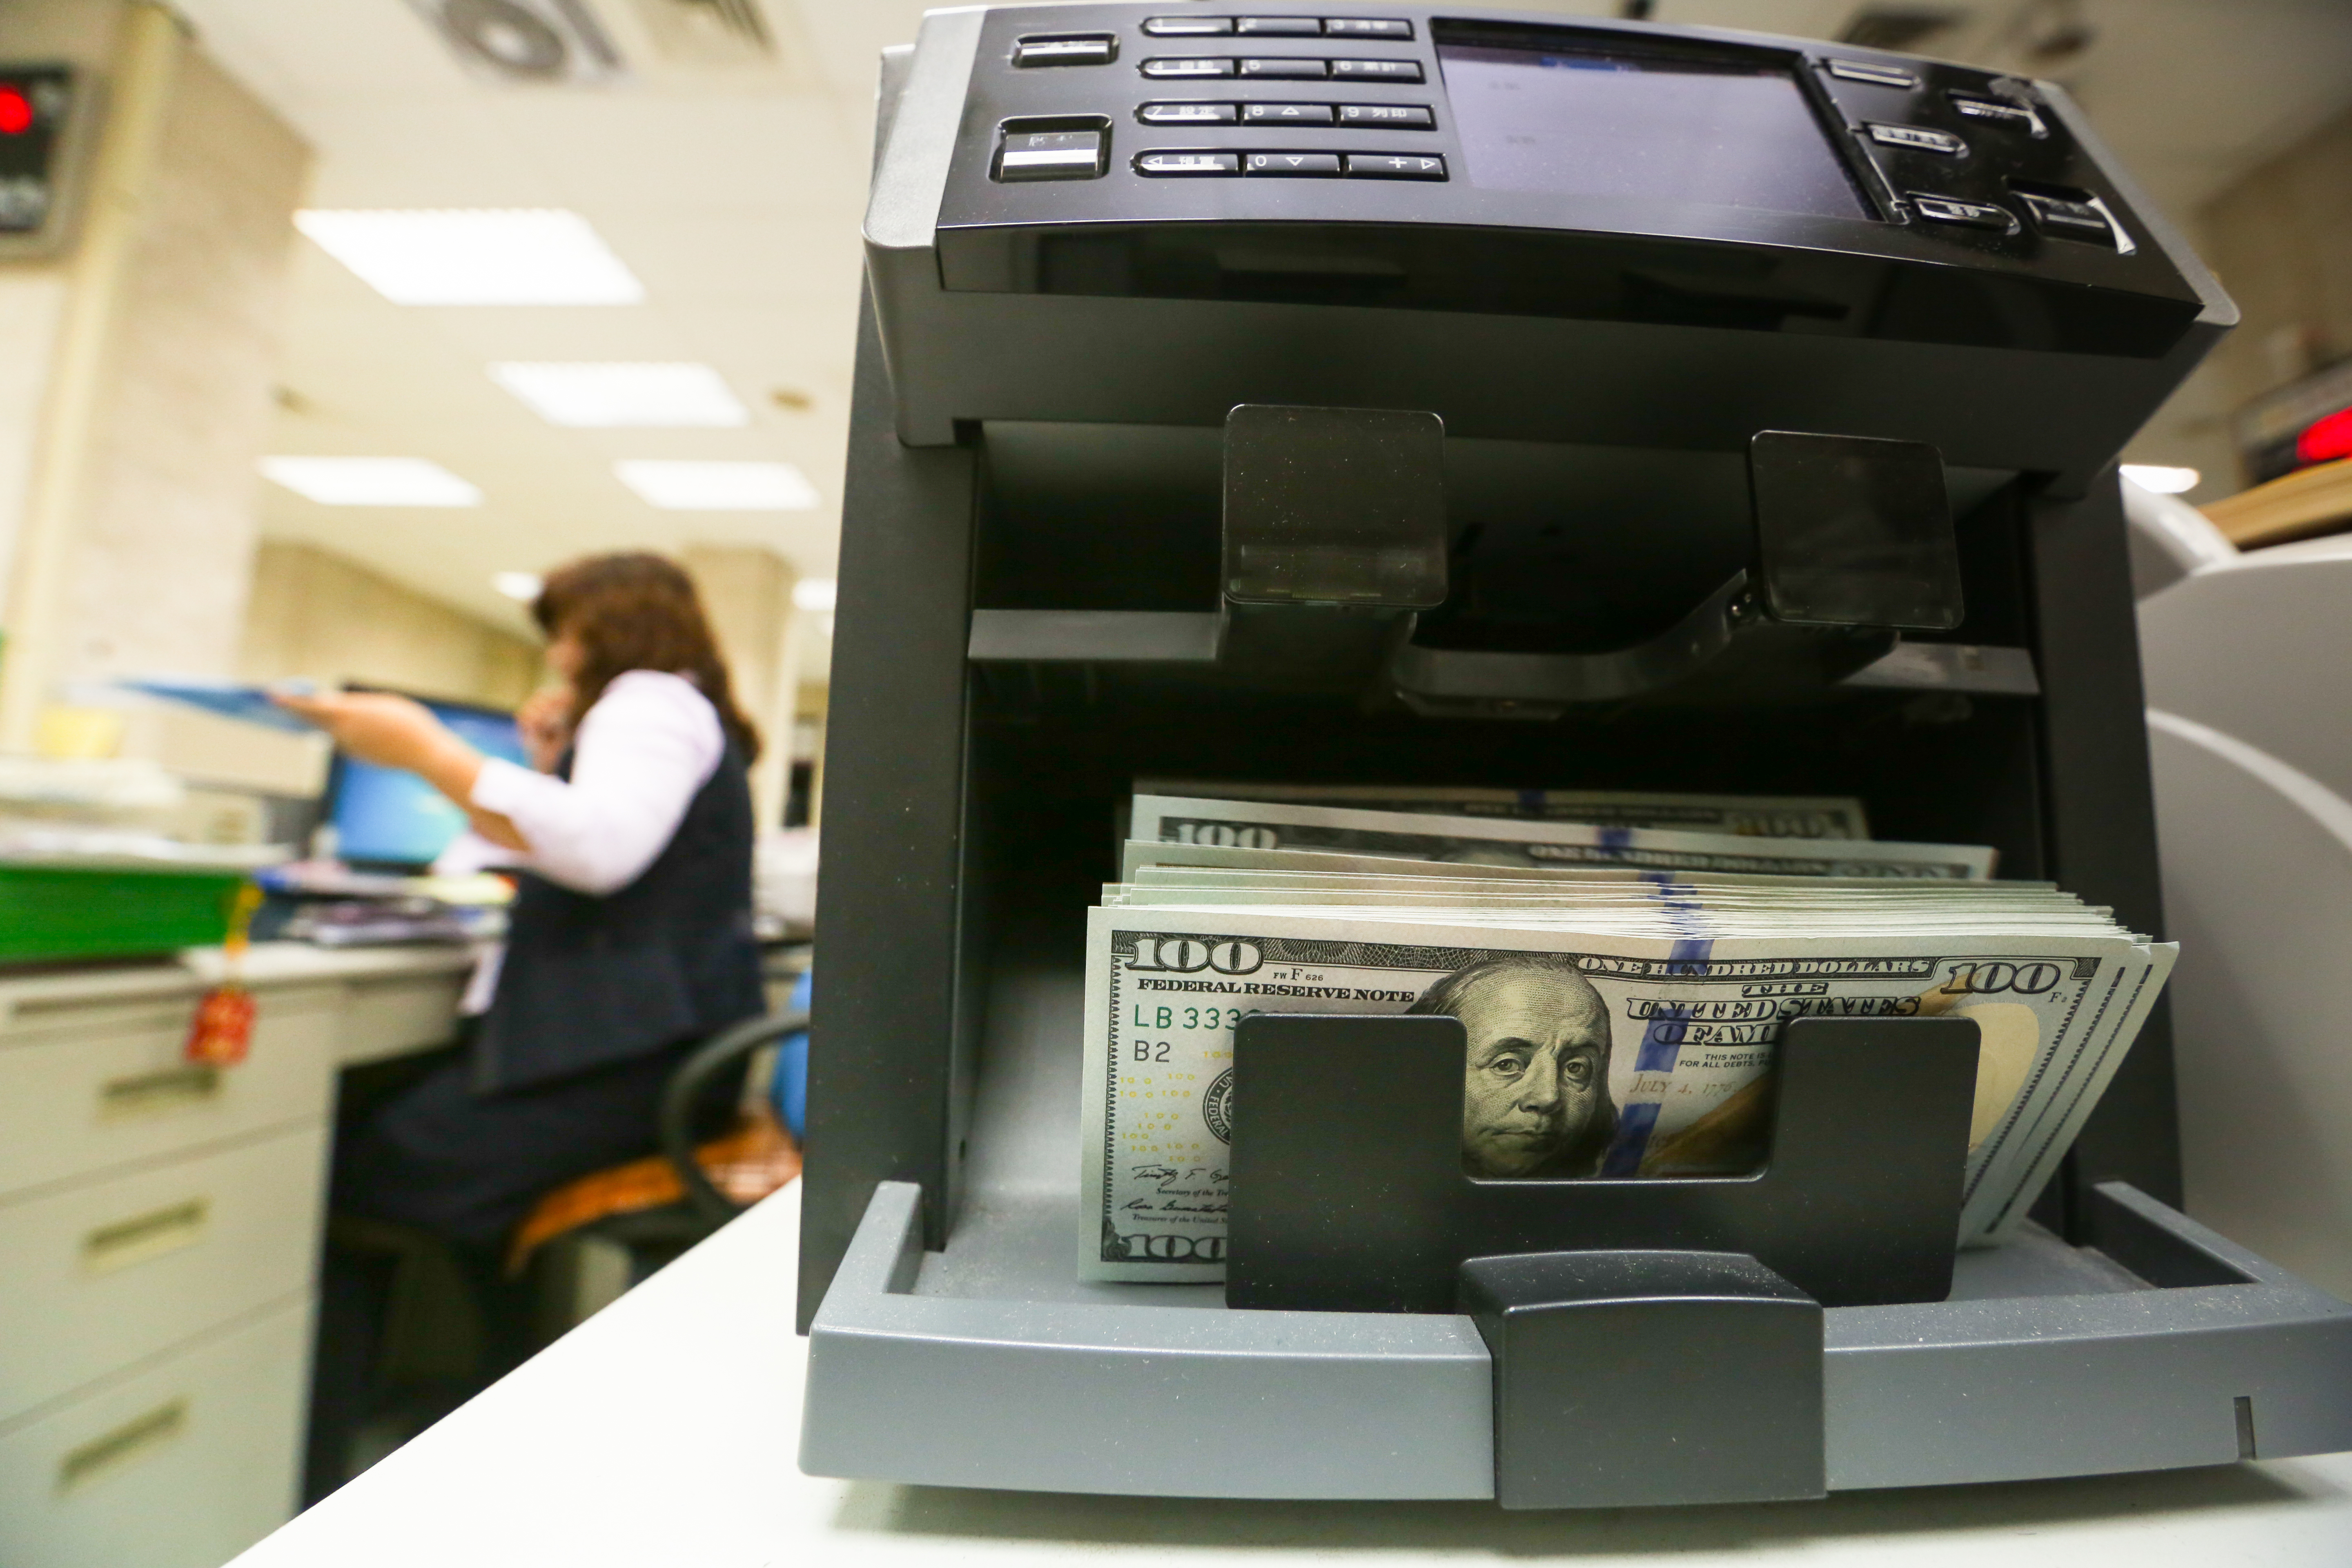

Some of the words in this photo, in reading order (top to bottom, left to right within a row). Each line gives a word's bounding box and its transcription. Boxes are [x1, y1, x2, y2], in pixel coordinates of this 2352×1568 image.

[1333, 19, 1345, 30] 3
[1154, 60, 1163, 70] 4
[1248, 60, 1260, 70] 5
[1339, 60, 1352, 71] 6
[1152, 106, 1163, 116] 7
[1179, 106, 1216, 116] 設定
[1251, 105, 1264, 116] 8
[1348, 107, 1359, 118] 9
[1372, 107, 1408, 118] 列印
[1255, 155, 1267, 167] 0
[1125, 936, 1264, 976] 100
[1578, 957, 1644, 975] ONE
[1645, 961, 1794, 976] HUNDRED
[1795, 960, 1930, 974] DOLLARS
[1290, 968, 1303, 980] F
[1940, 962, 2061, 994] 100
[1137, 978, 1242, 994] FEDERAL
[1243, 982, 1350, 999] RESERVE
[1352, 989, 1415, 1002] NOTE
[1742, 982, 1829, 998] THE
[1626, 998, 1777, 1022] UNITED
[1776, 996, 1922, 1020] STATES
[1183, 1007, 1260, 1030] 333
[1653, 1023, 1713, 1046] OF
[1704, 1022, 1780, 1046] AM
[1134, 1040, 1171, 1063] B2
[1208, 1096, 1229, 1136] FEDERAL
[1156, 1187, 1191, 1197] Secretary
[1193, 1189, 1201, 1198] of
